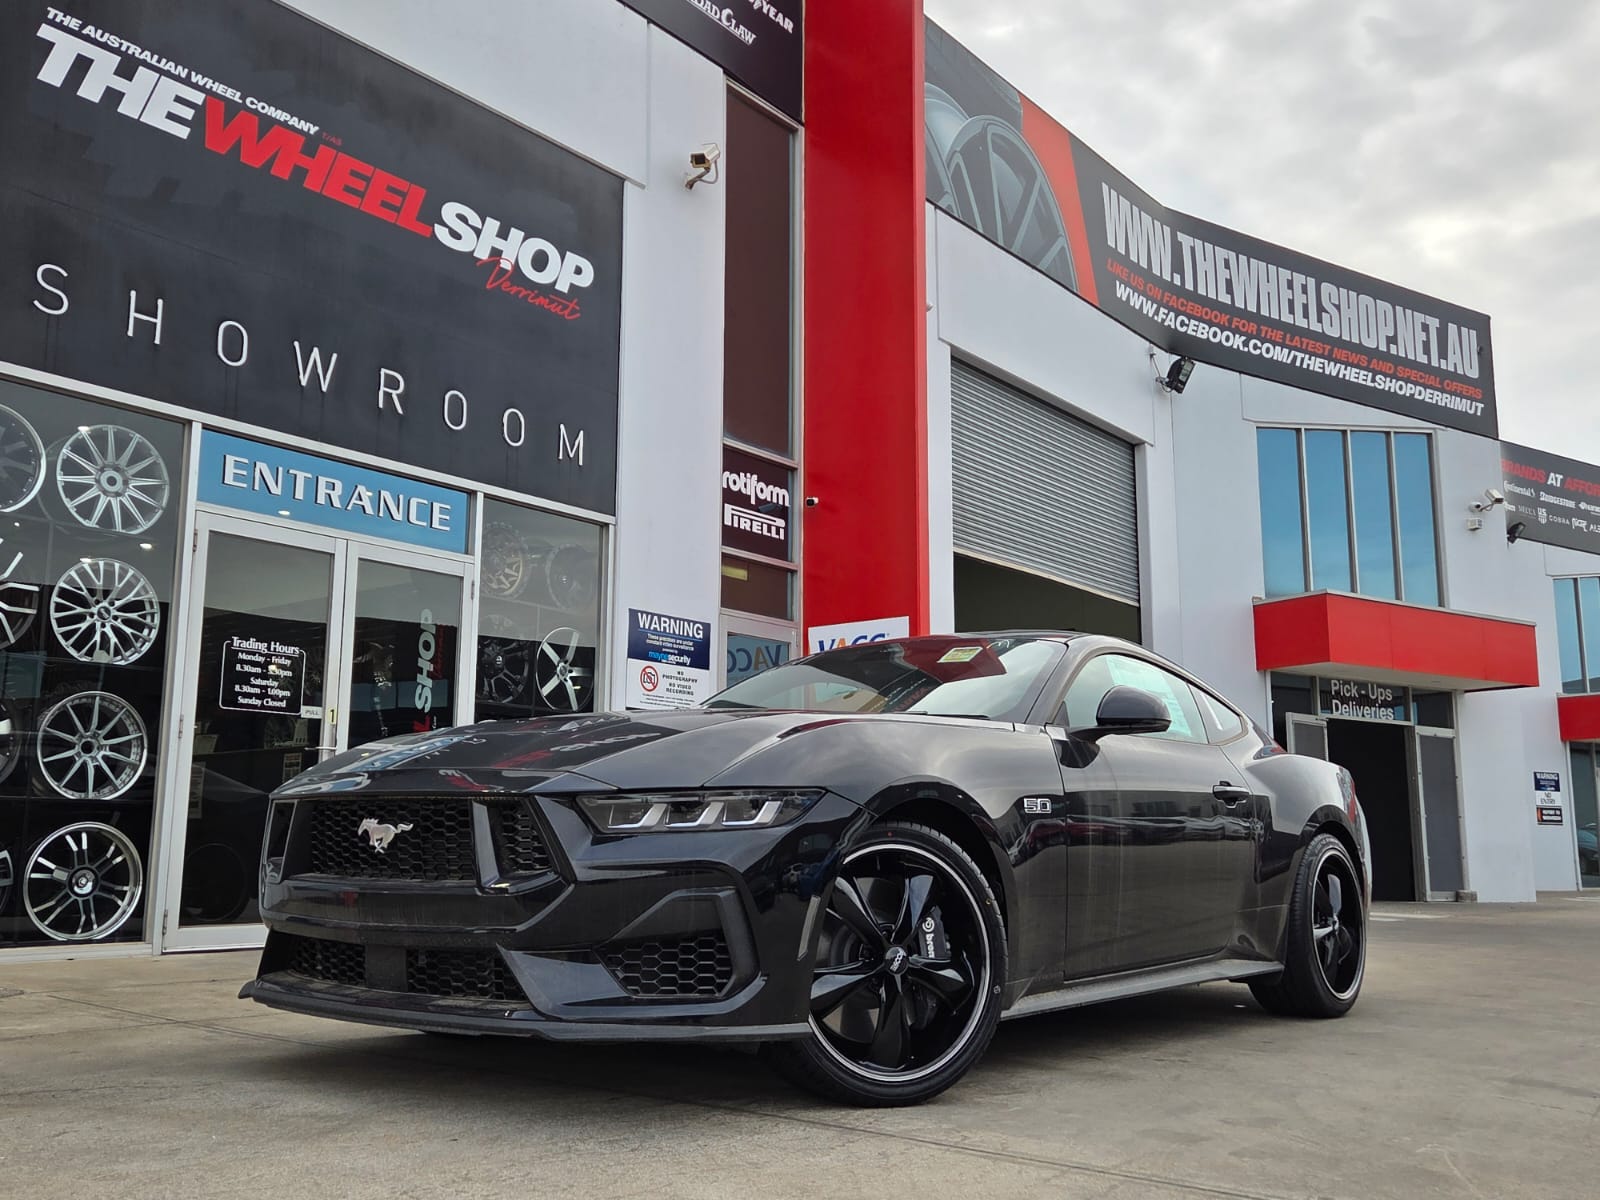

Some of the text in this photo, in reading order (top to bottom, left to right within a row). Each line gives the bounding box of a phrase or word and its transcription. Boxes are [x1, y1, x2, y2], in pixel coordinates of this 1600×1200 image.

[47, 7, 82, 31] THE
[82, 25, 188, 79] AUSTRALIAN
[191, 70, 243, 104] WHEEL
[245, 97, 320, 135] COMPANY
[476, 257, 581, 320] Derrimut
[1102, 181, 1480, 379] WWW.THEWHEELSHOP.NET.AU
[1106, 258, 1482, 399] LIKE US ON FACEBOOK FOR THE LATEST NEWS AND SPECIAL OFFERS
[33, 263, 585, 467] SHOWROOM
[1116, 280, 1484, 416] WWW.FACEBOOK.COM/THEWHEELSHOPDERRIMUT
[222, 454, 451, 531] ENTRANCE
[722, 471, 789, 507] rotiform
[1547, 472, 1563, 487] AT
[724, 503, 786, 540] PIRELLI
[638, 612, 703, 639] WARNING
[231, 636, 300, 655] Trading Hours
[238, 652, 265, 664] Monday
[271, 656, 291, 667] Friday
[414, 609, 437, 713] SHOP
[250, 676, 279, 689] Saturday
[1331, 680, 1359, 698] Pick
[1368, 683, 1393, 702] Ups
[238, 696, 287, 708] Sunday Closed
[1332, 700, 1394, 720] Deliveries
